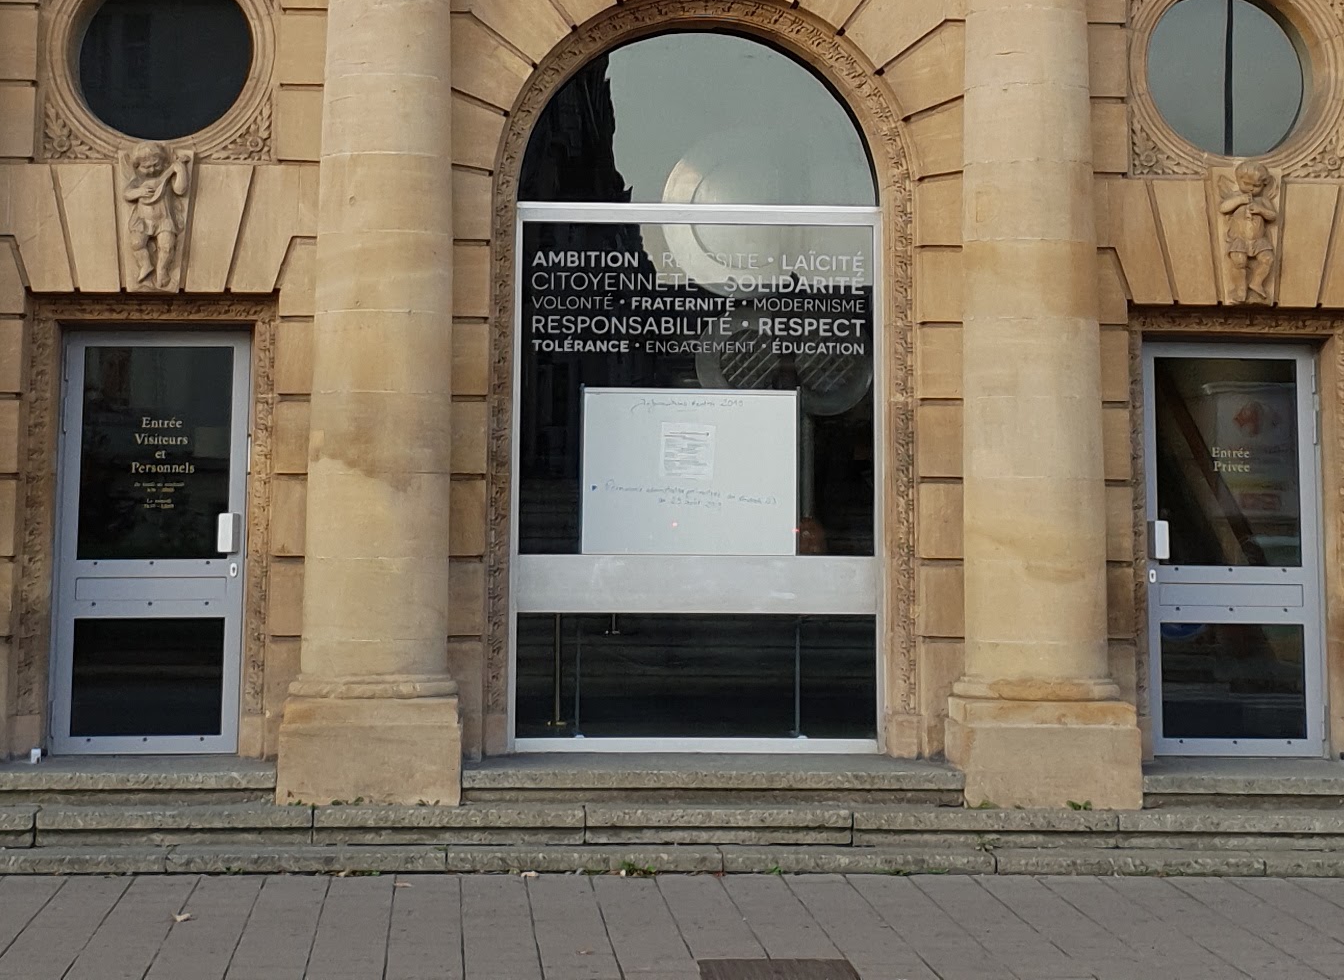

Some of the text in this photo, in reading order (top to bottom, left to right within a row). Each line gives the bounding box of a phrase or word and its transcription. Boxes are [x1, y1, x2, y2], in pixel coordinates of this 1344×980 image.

[531, 251, 639, 268] AMBITION
[782, 250, 865, 271] LAÏCITÉ
[723, 272, 865, 295] SOLIDARITÉ
[531, 294, 866, 313] VOLONTÉ FRATERNITÉ MODERNISME
[532, 313, 866, 337] RESPONSABILITÉ RESPECT
[532, 335, 865, 355] TOLÉRANCE ENGAGEMENT ÉDUCATION
[142, 416, 183, 428] Entrée
[134, 433, 188, 445] Visiteurs
[155, 450, 166, 459] et
[1211, 447, 1250, 459] Entrée
[131, 461, 195, 474] Personnels
[1213, 460, 1251, 472] Privée
